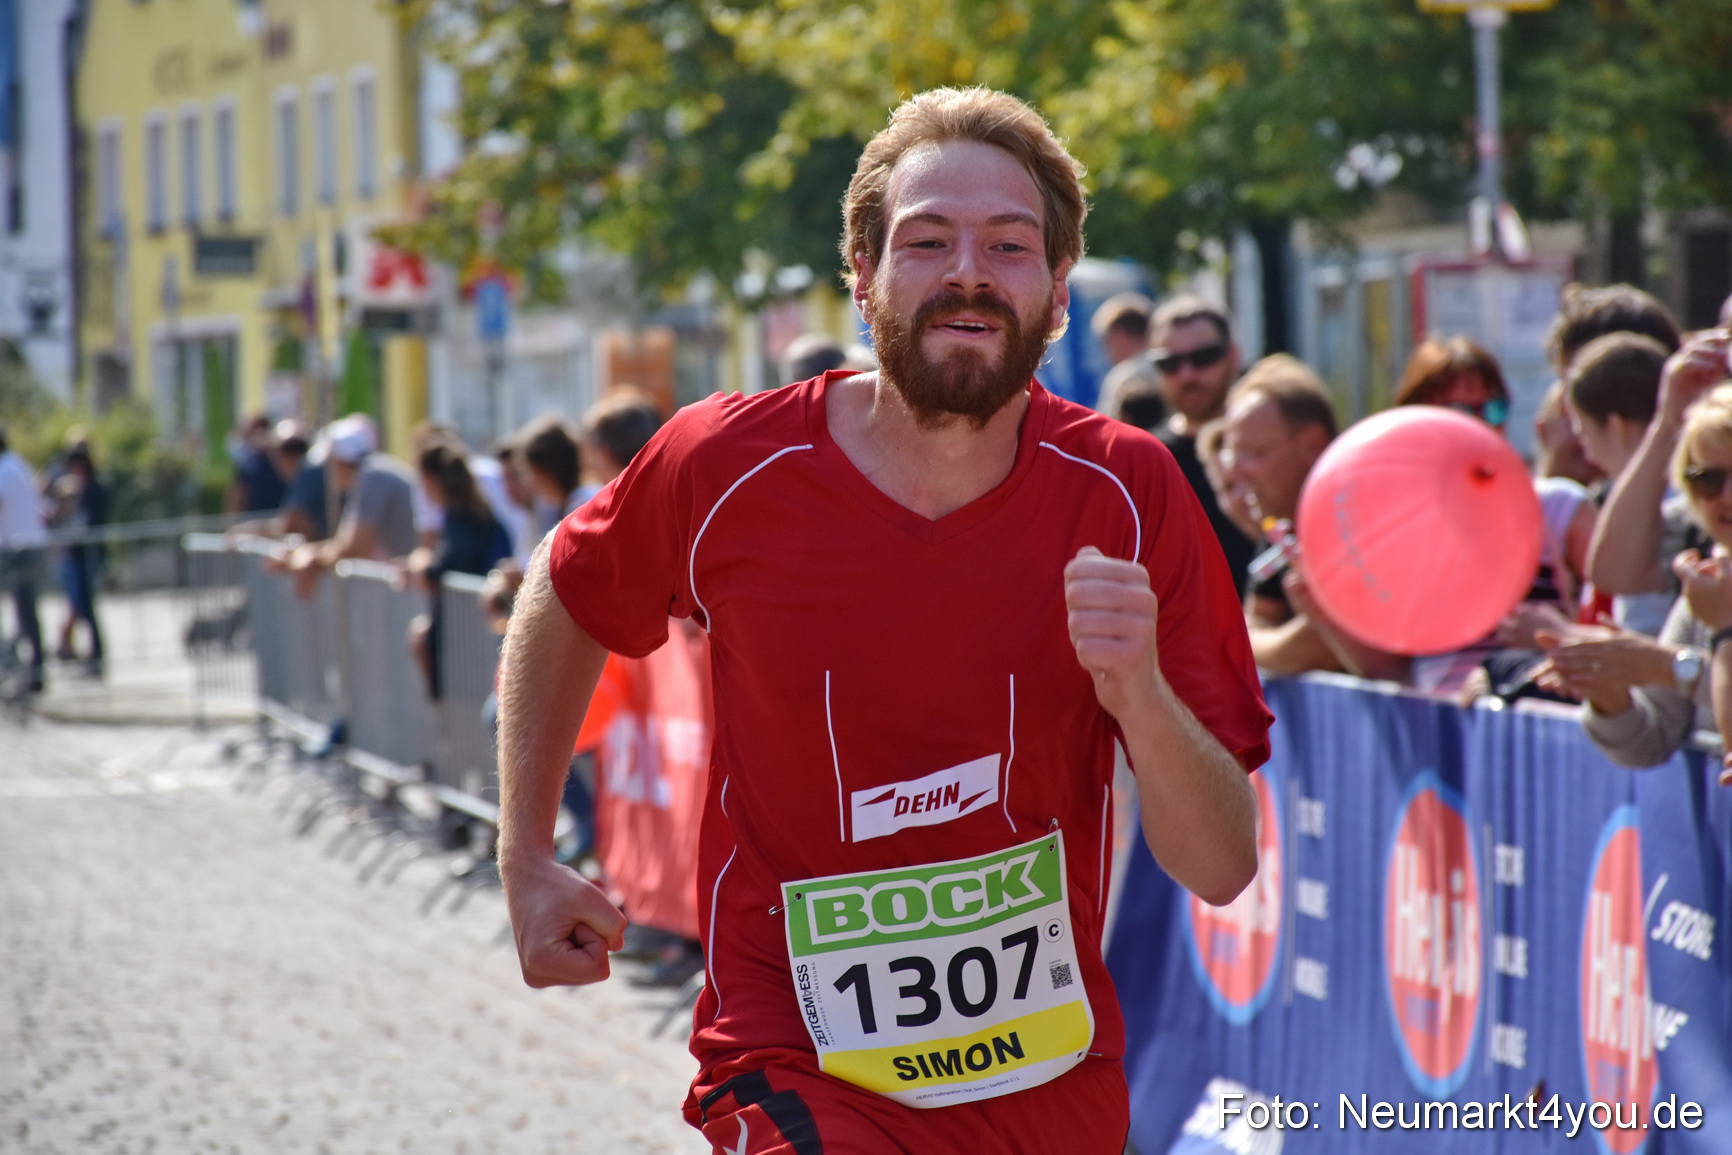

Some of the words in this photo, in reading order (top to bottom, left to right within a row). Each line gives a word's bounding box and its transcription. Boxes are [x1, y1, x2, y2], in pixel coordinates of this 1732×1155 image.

[893, 781, 960, 818] DEHN
[811, 859, 1034, 938] BOCK
[1048, 924, 1059, 937] C
[811, 961, 823, 1004] ZEITMESSUNG
[833, 925, 1039, 1034] 1307
[819, 1007, 836, 1045] TRANSPONDER
[892, 1031, 1026, 1081] SIMON
